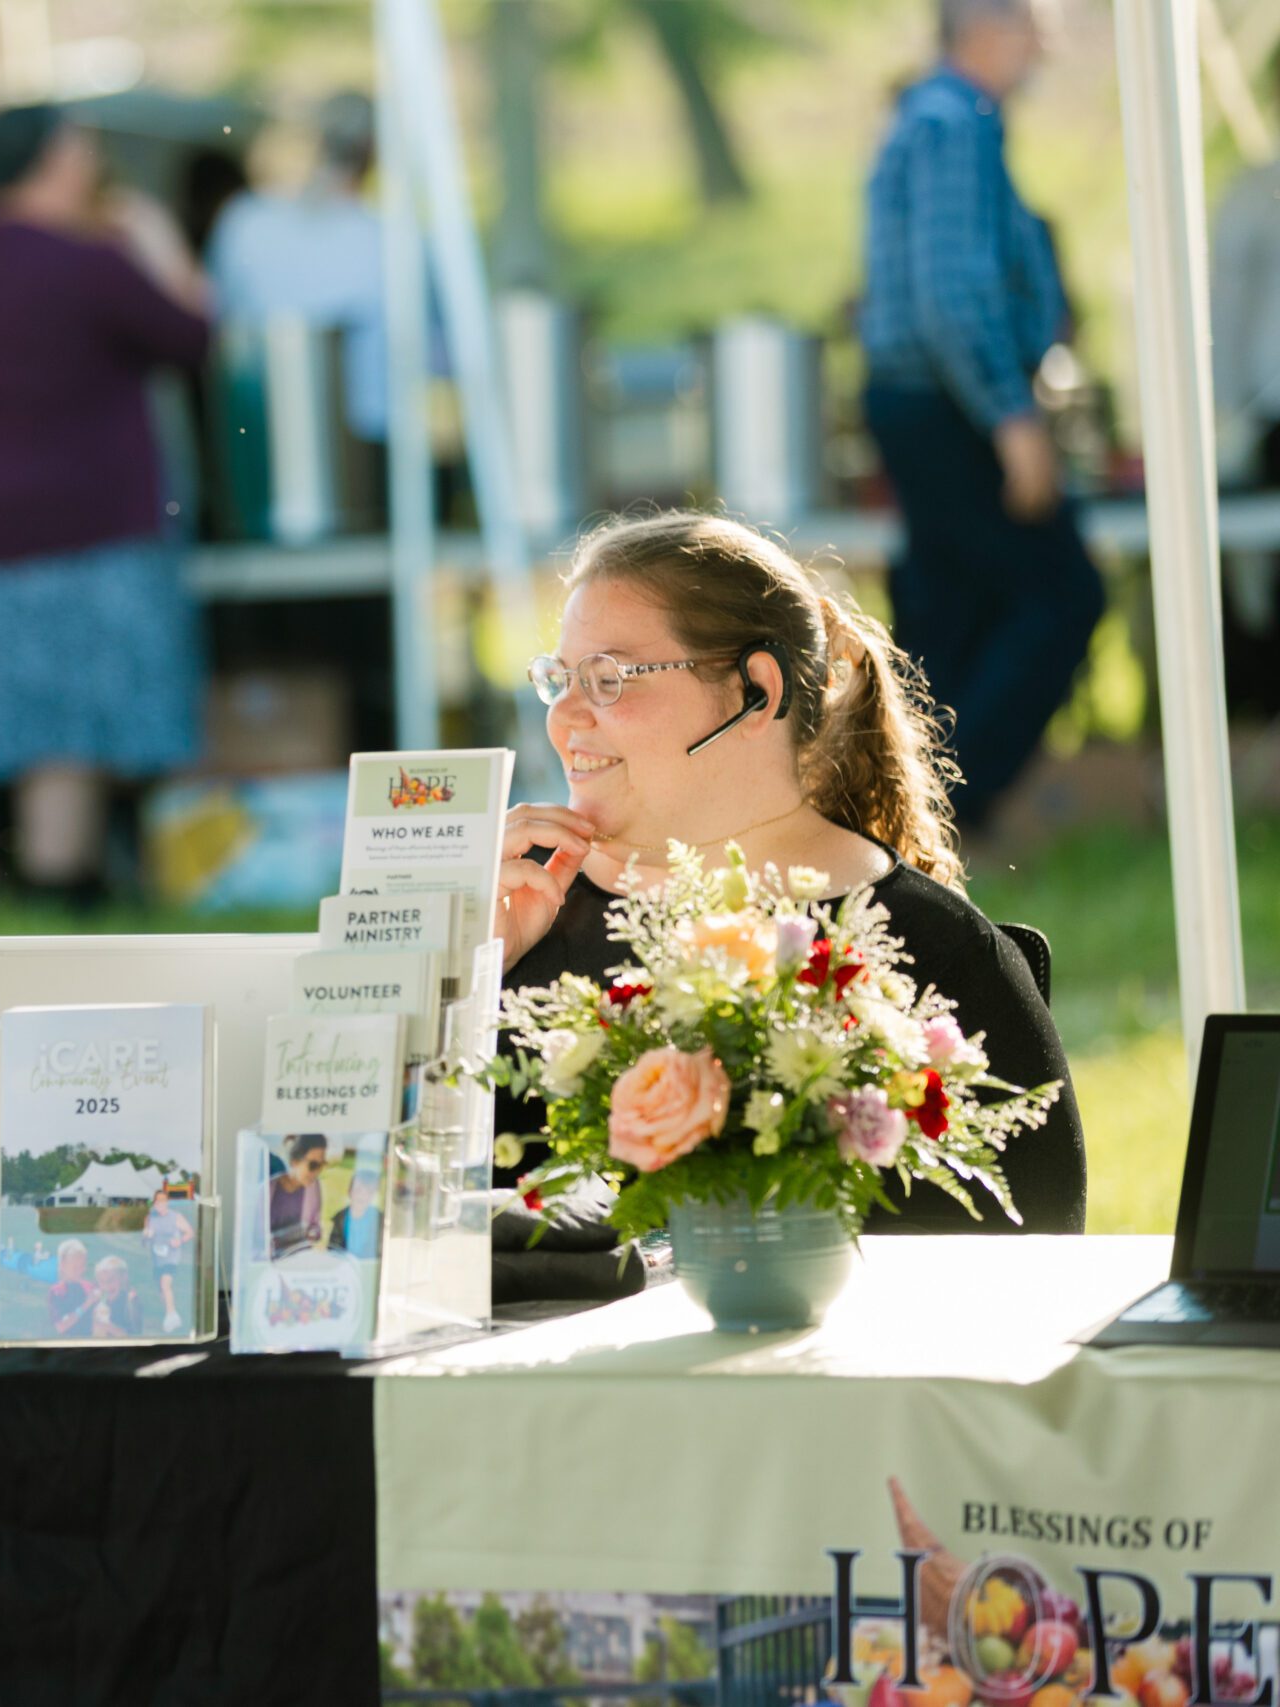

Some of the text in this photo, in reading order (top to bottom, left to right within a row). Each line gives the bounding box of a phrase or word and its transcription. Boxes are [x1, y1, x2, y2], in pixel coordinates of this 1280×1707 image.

[389, 775, 457, 800] HOPE
[372, 825, 464, 840] WHO WE ARE
[347, 909, 422, 925] PARTNER
[344, 927, 422, 943] MINISTRY
[304, 984, 402, 1000] VOLUNTEER
[39, 1040, 160, 1074] iCARE
[276, 1032, 381, 1085] Introducing
[276, 1084, 380, 1100] BLESSINGS OF
[75, 1098, 121, 1114] 2025
[307, 1103, 348, 1116] HOPE
[962, 1501, 1212, 1552] BLESSINGS OF
[824, 1548, 1278, 1707] HOPE
